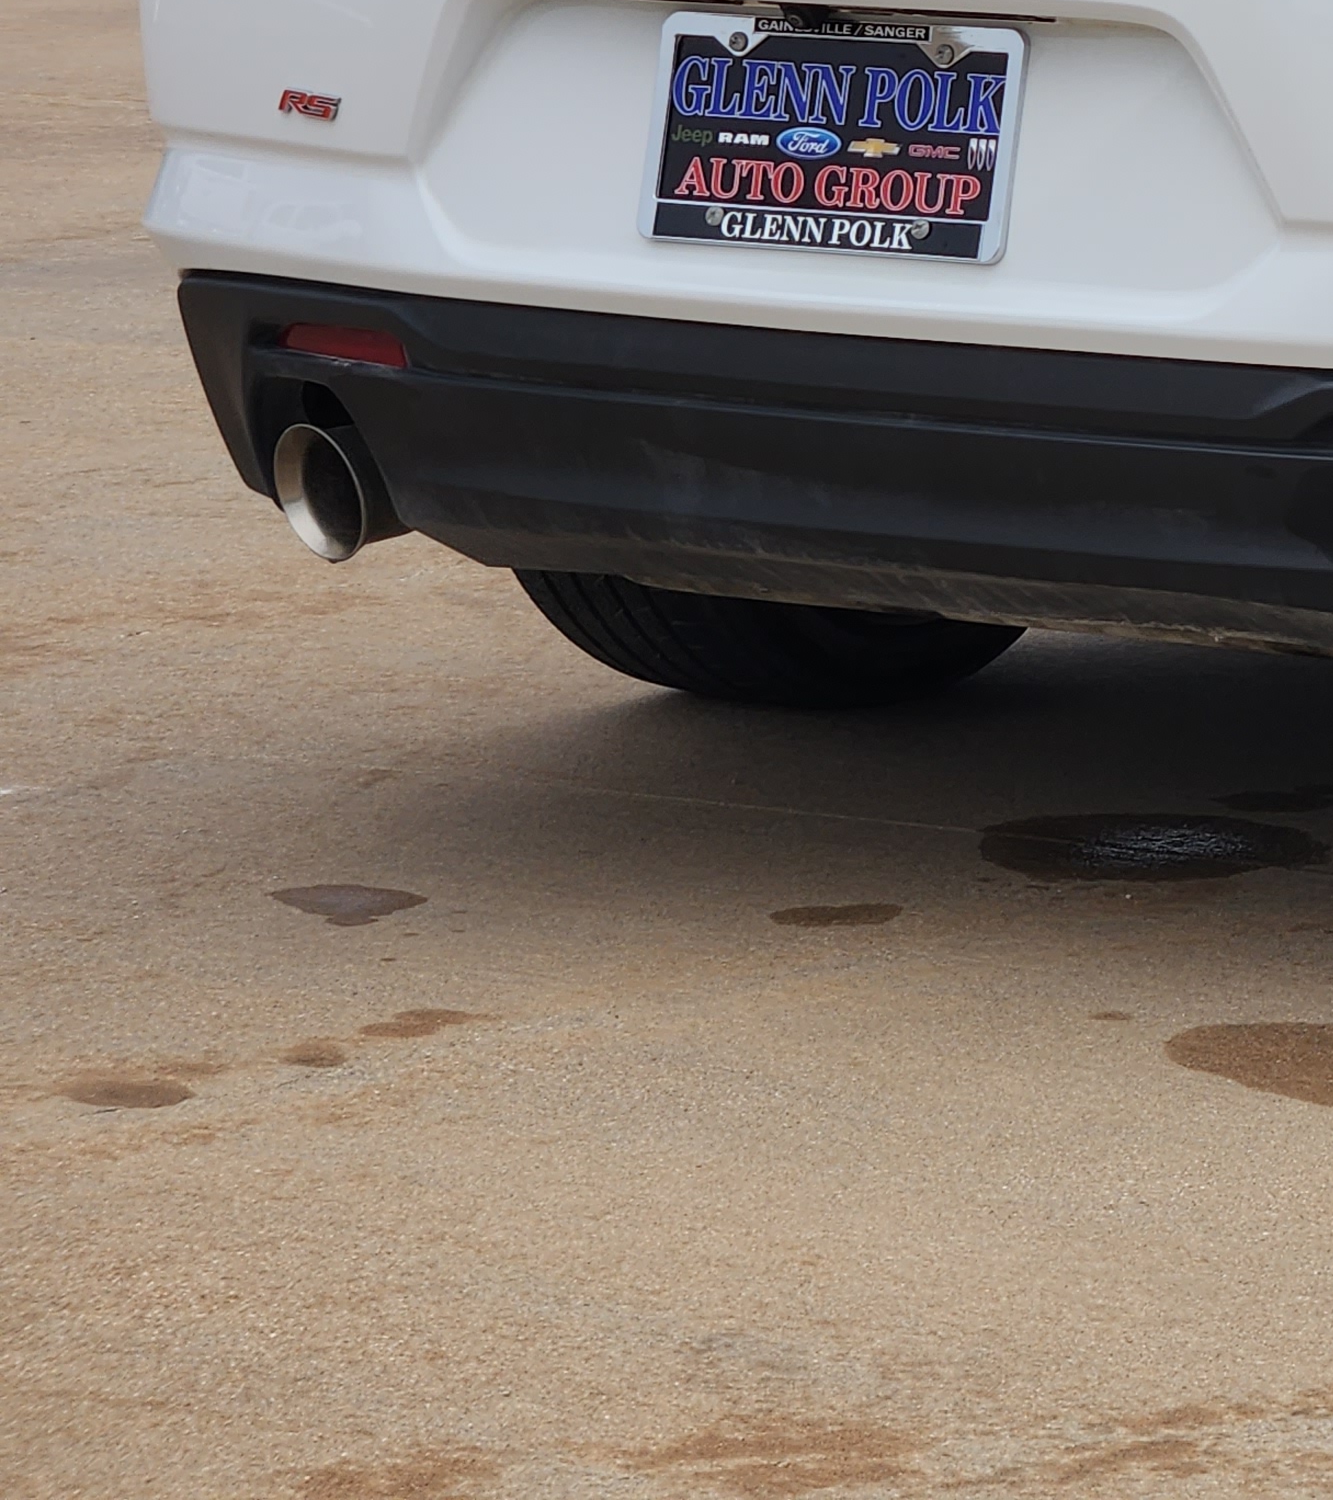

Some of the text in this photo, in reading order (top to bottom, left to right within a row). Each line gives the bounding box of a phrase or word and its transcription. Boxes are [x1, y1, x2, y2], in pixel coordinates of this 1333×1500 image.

[278, 88, 341, 121] RS
[672, 55, 1007, 136] GLENN POLK
[671, 124, 961, 160] Jeep RAM Ford GMC
[674, 156, 981, 215] AUTO GROUP
[720, 211, 913, 250] GLENN POLK
